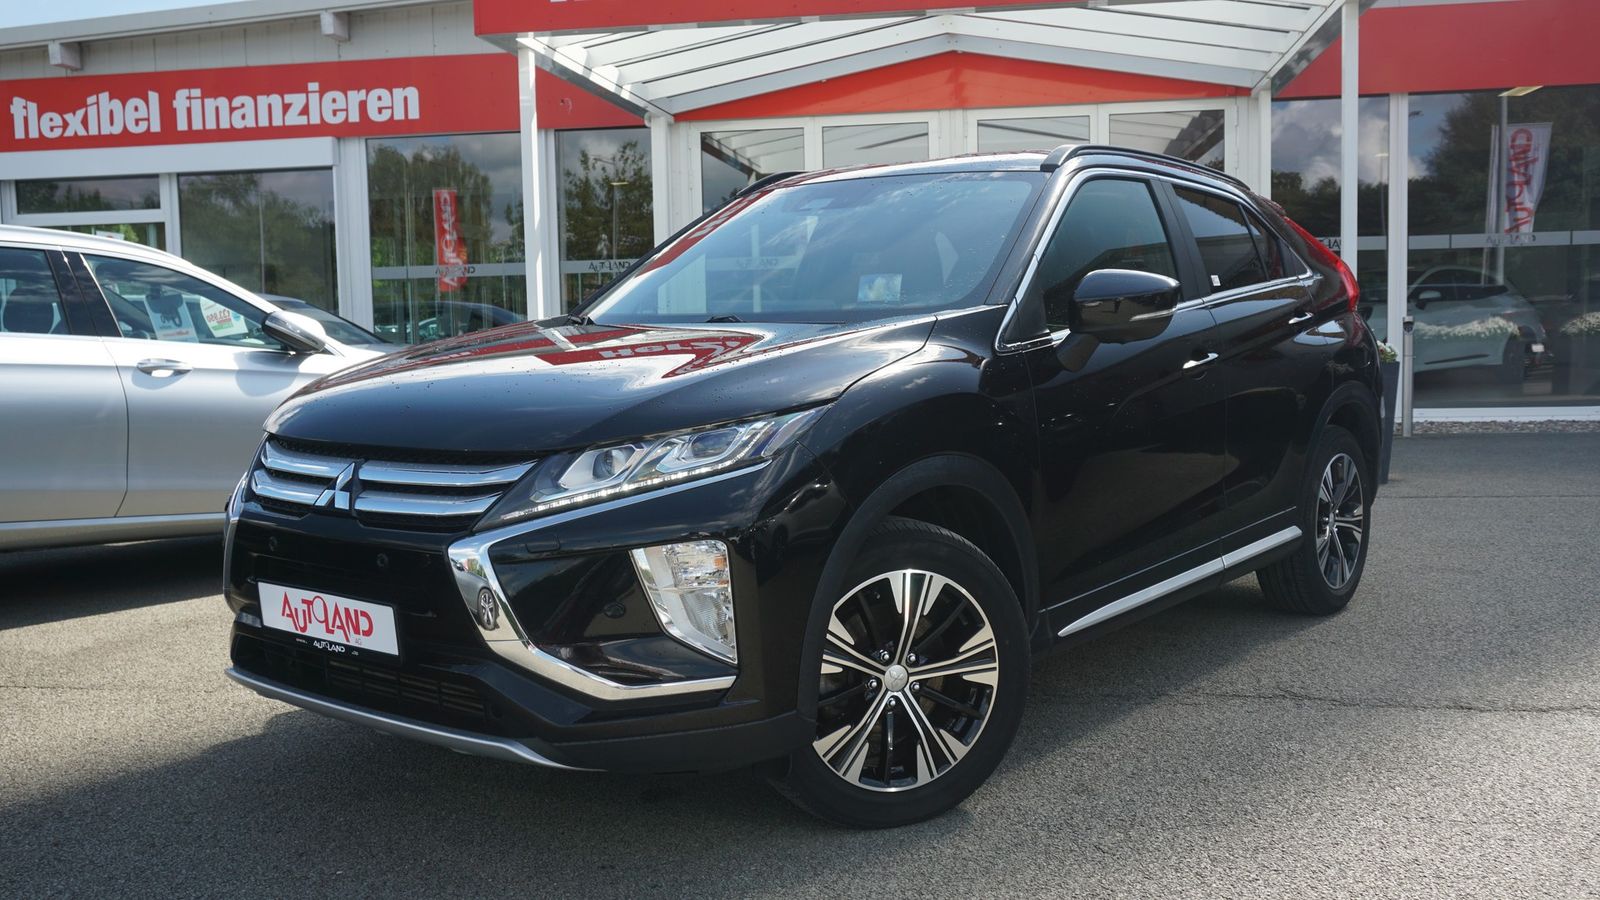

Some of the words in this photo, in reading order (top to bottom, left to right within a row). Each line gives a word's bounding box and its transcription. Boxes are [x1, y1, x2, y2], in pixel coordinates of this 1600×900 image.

[10, 90, 161, 140] flexibel
[173, 82, 421, 132] finanzieren
[281, 592, 374, 643] AUTOLAND
[313, 640, 346, 653] AUTOLAND
